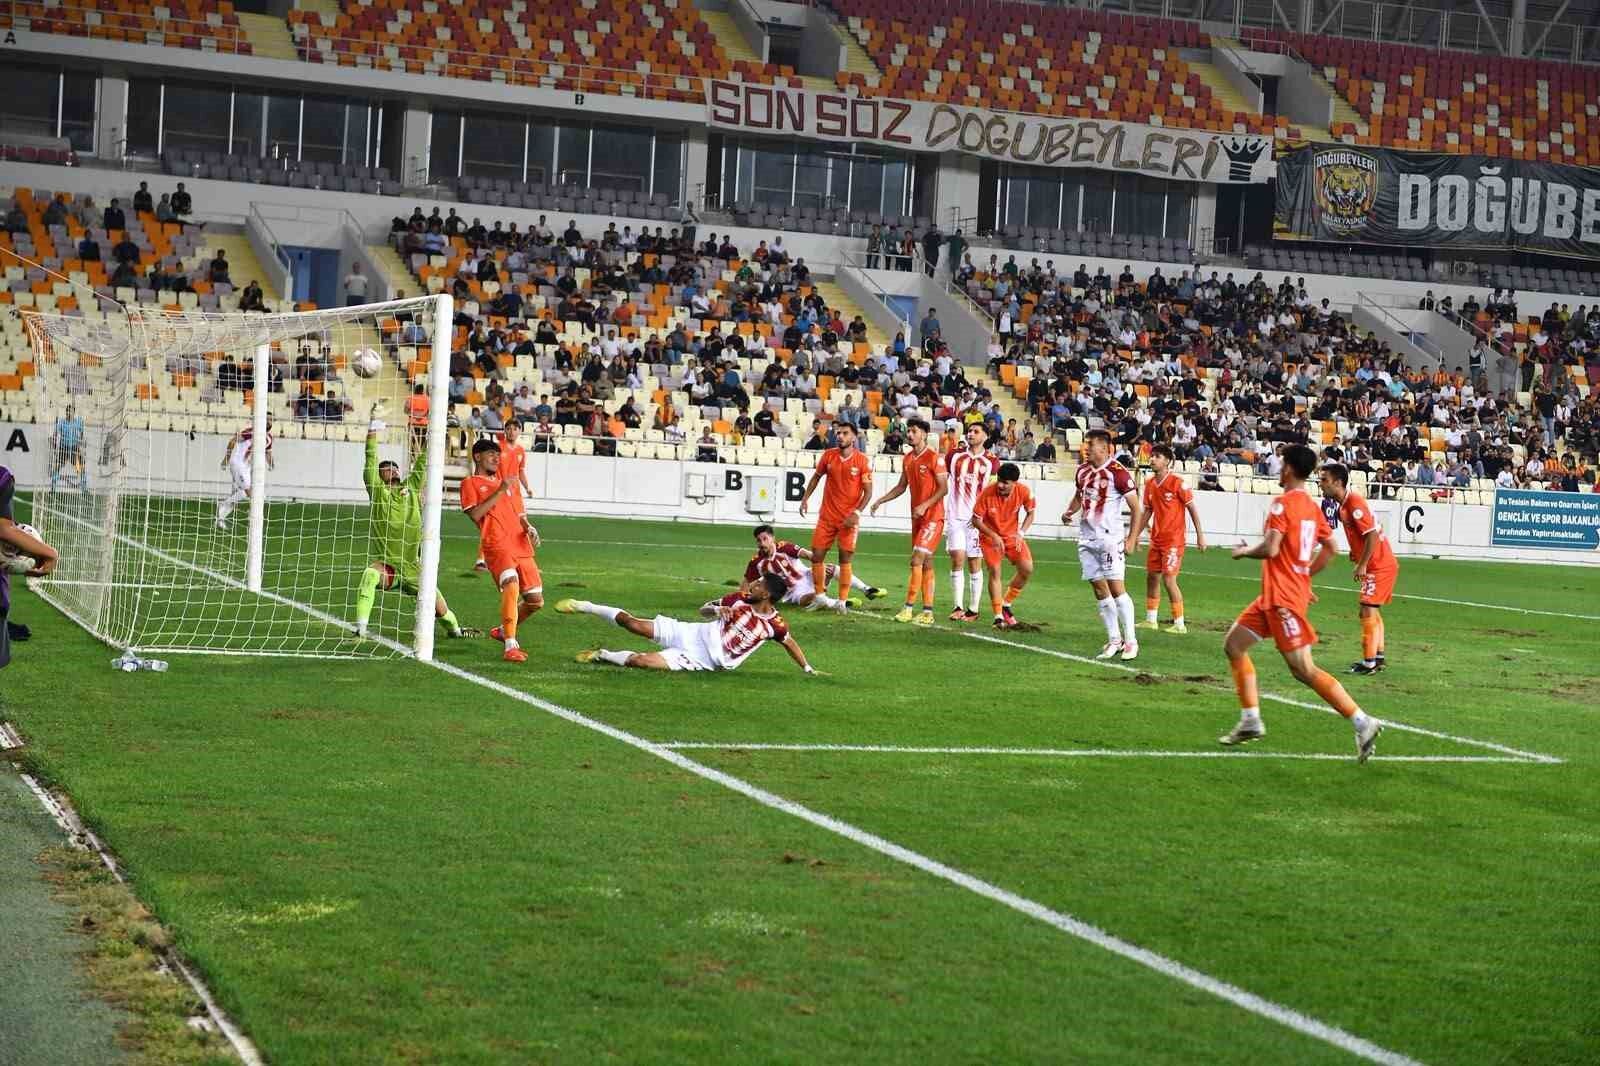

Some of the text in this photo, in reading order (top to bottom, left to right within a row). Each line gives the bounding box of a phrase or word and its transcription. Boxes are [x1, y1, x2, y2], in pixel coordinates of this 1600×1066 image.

[4, 31, 17, 45] A
[575, 93, 585, 105] B
[711, 80, 805, 132] SON
[925, 104, 1220, 180] DOĞUBEYLERİ
[1398, 166, 1600, 245] DOĞUBE
[5, 428, 30, 452] A
[725, 470, 743, 491] B
[785, 471, 806, 501] B
[1498, 511, 1529, 523] GENÇLİK
[1531, 514, 1540, 523] VE
[1541, 514, 1561, 524] SPOR
